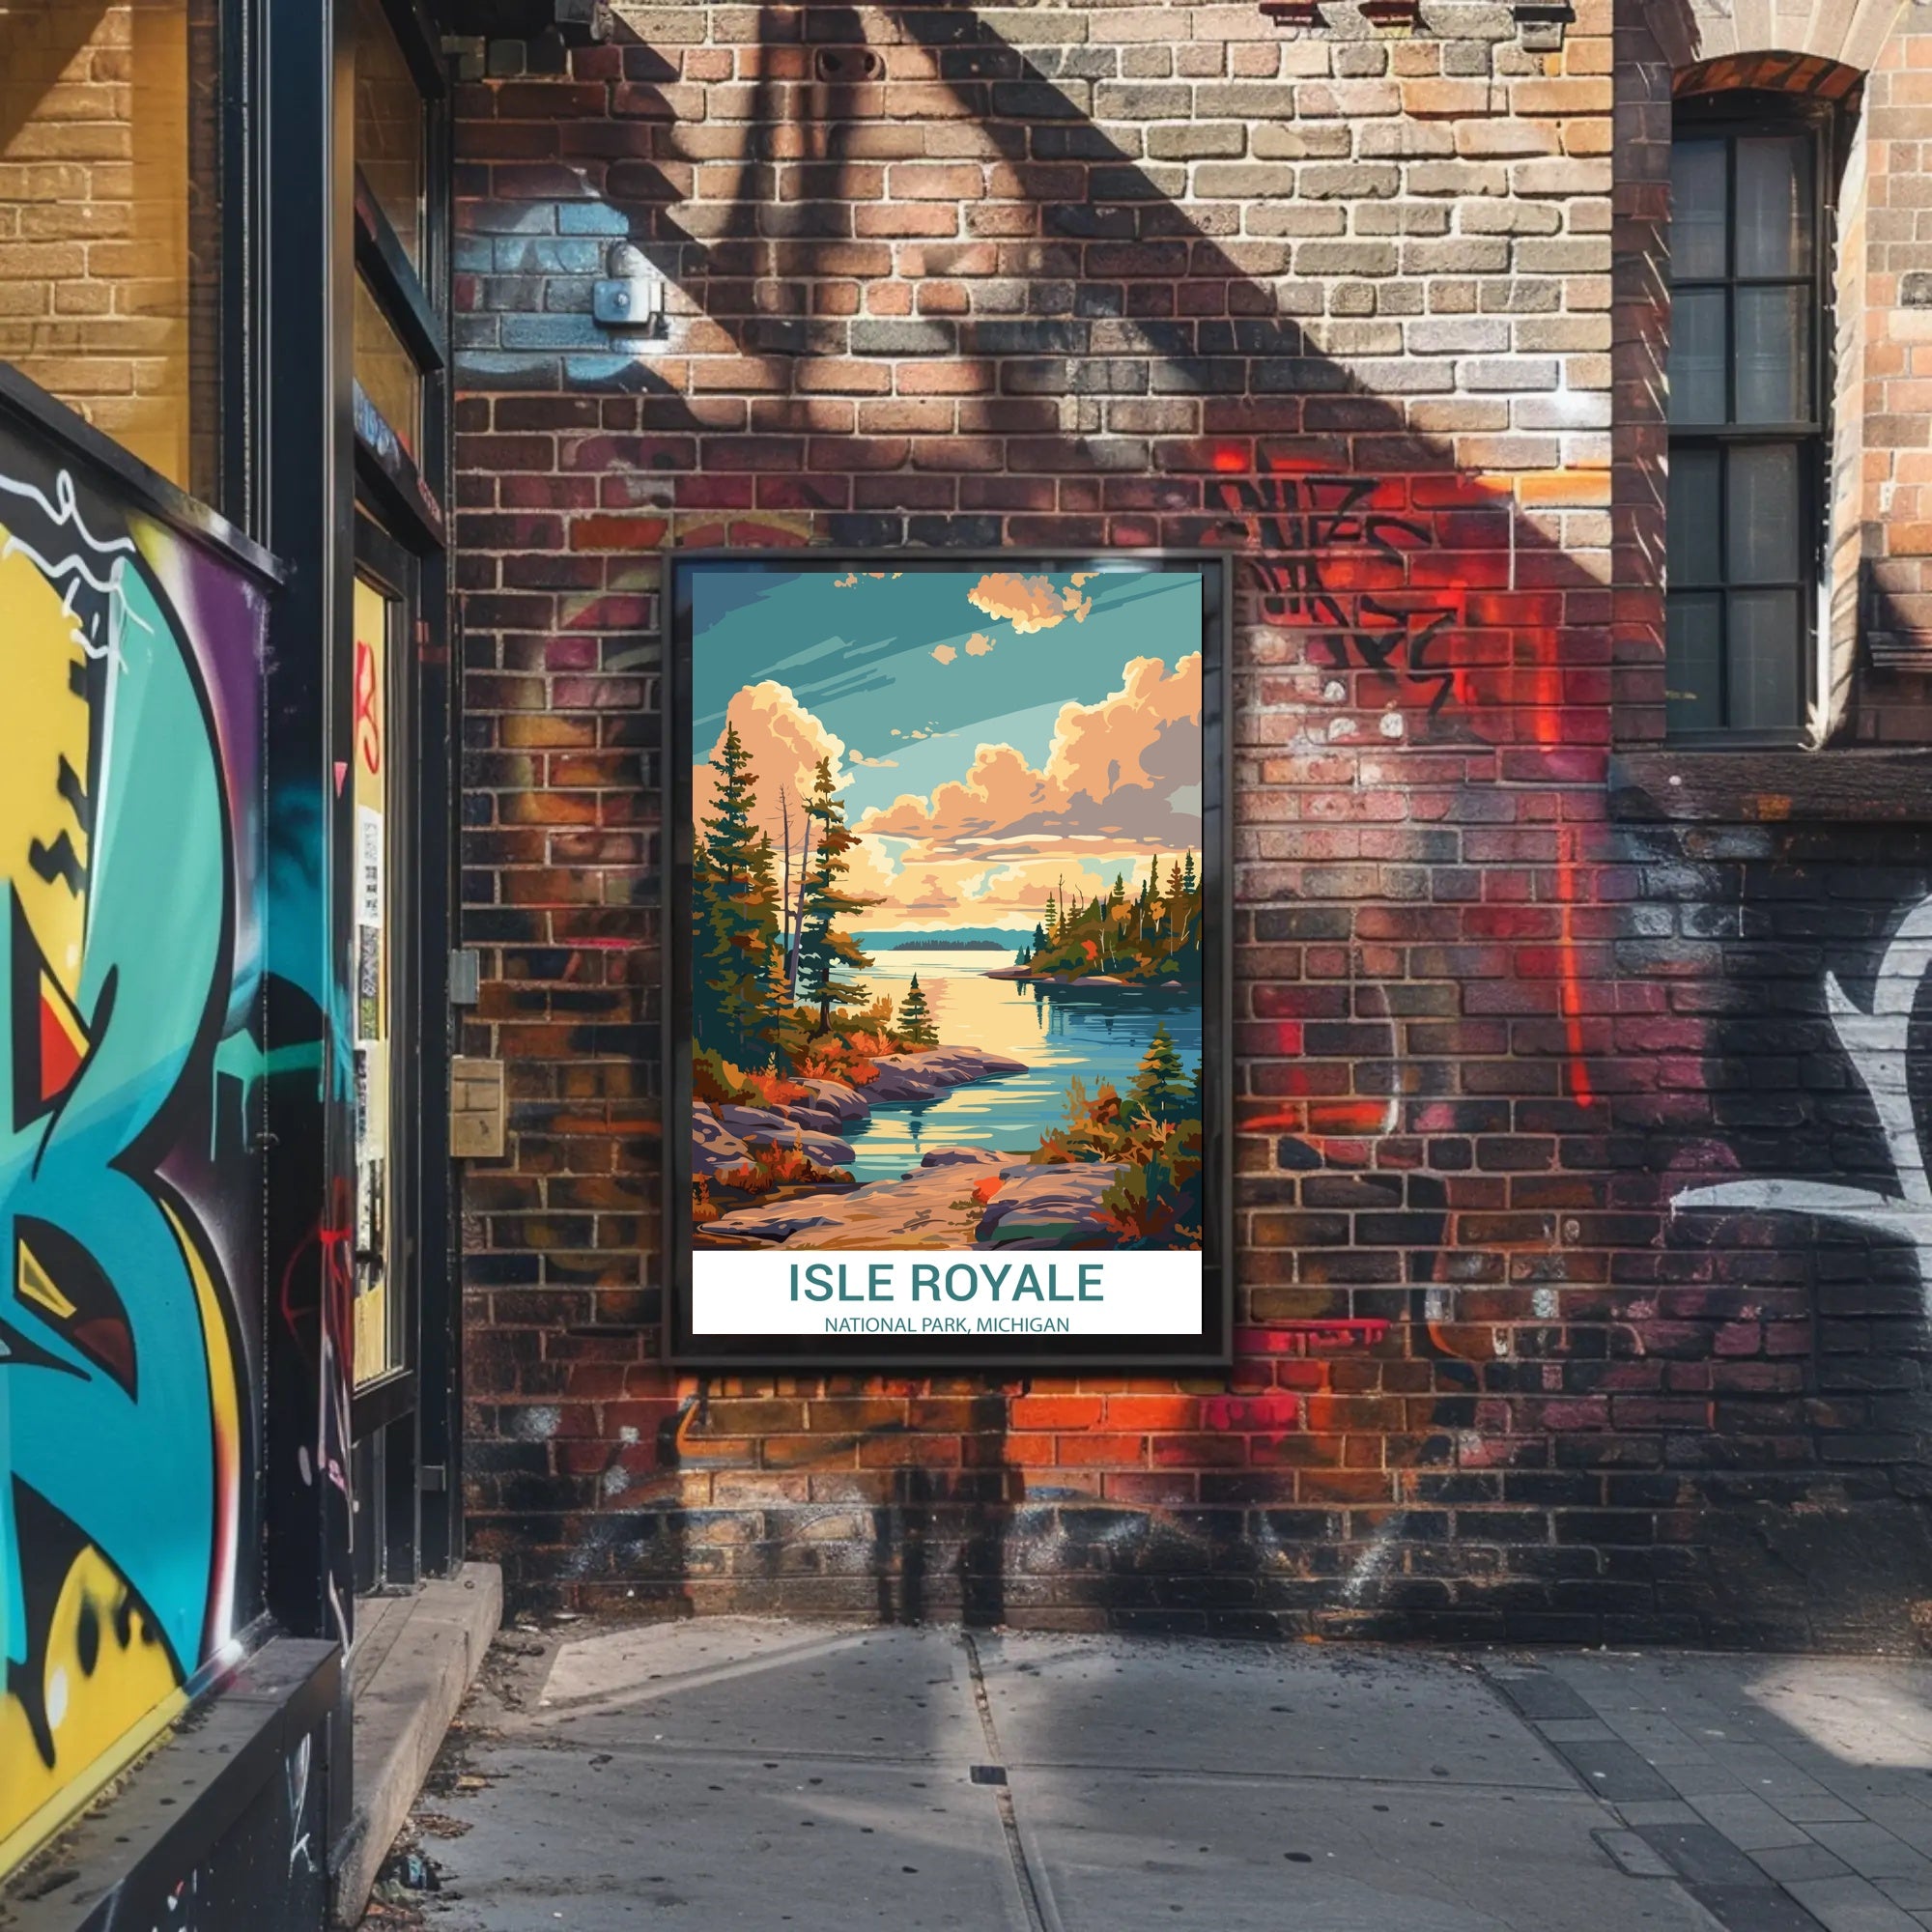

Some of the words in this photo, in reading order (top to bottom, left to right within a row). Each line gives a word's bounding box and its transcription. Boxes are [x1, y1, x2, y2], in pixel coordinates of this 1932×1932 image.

[790, 1264, 894, 1302] ISLE
[912, 1264, 1104, 1302] ROYALE
[825, 1317, 917, 1332] NATIONAL
[923, 1317, 971, 1334] PARK,
[977, 1317, 1069, 1332] MICHIGAN
